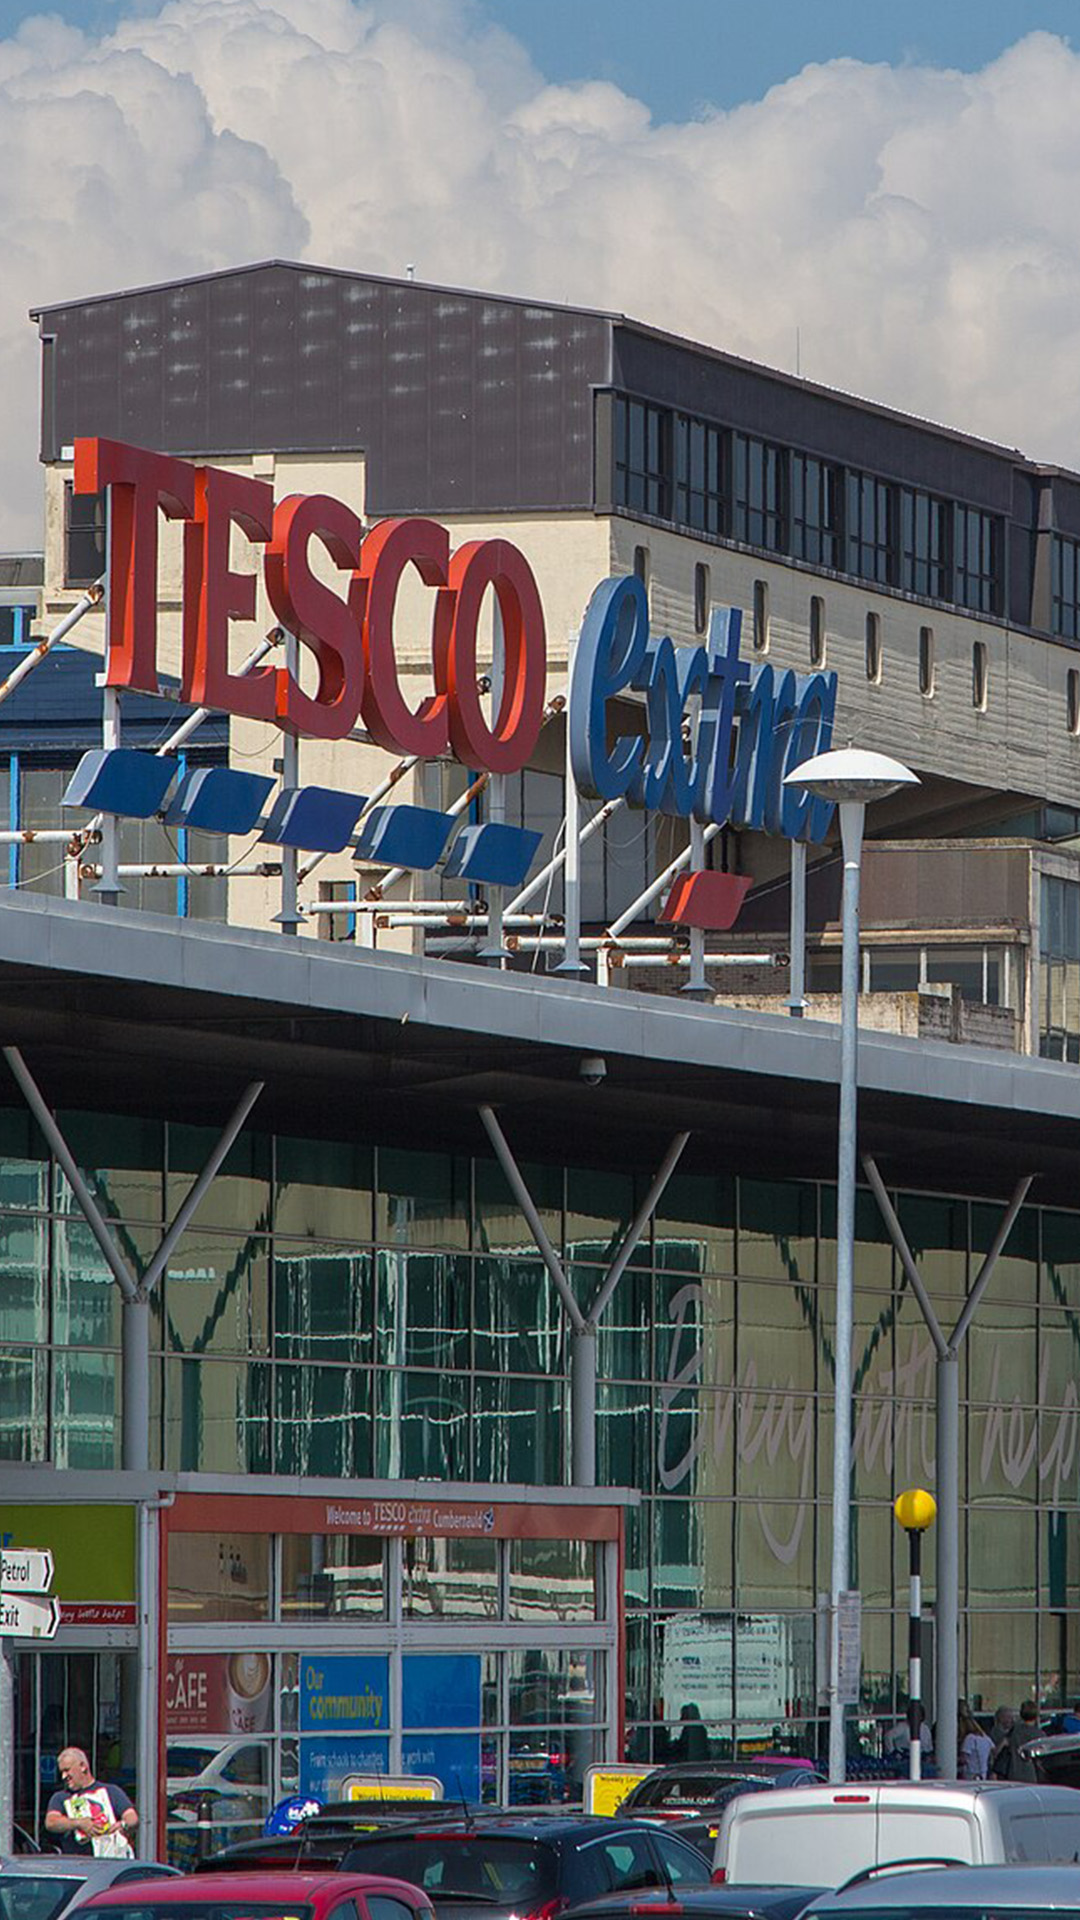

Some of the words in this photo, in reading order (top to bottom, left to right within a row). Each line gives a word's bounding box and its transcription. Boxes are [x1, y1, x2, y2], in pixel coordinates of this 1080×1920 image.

[75, 437, 546, 773] TESCO
[569, 575, 838, 844] extra
[326, 1505, 361, 1525] Welcome
[362, 1509, 371, 1526] to
[373, 1502, 406, 1522] TESCO
[408, 1505, 432, 1524] extra
[433, 1509, 484, 1529] Cumbernauld
[1, 1558, 30, 1581] Petrol
[305, 1666, 324, 1691] Our
[308, 1684, 383, 1727] community
